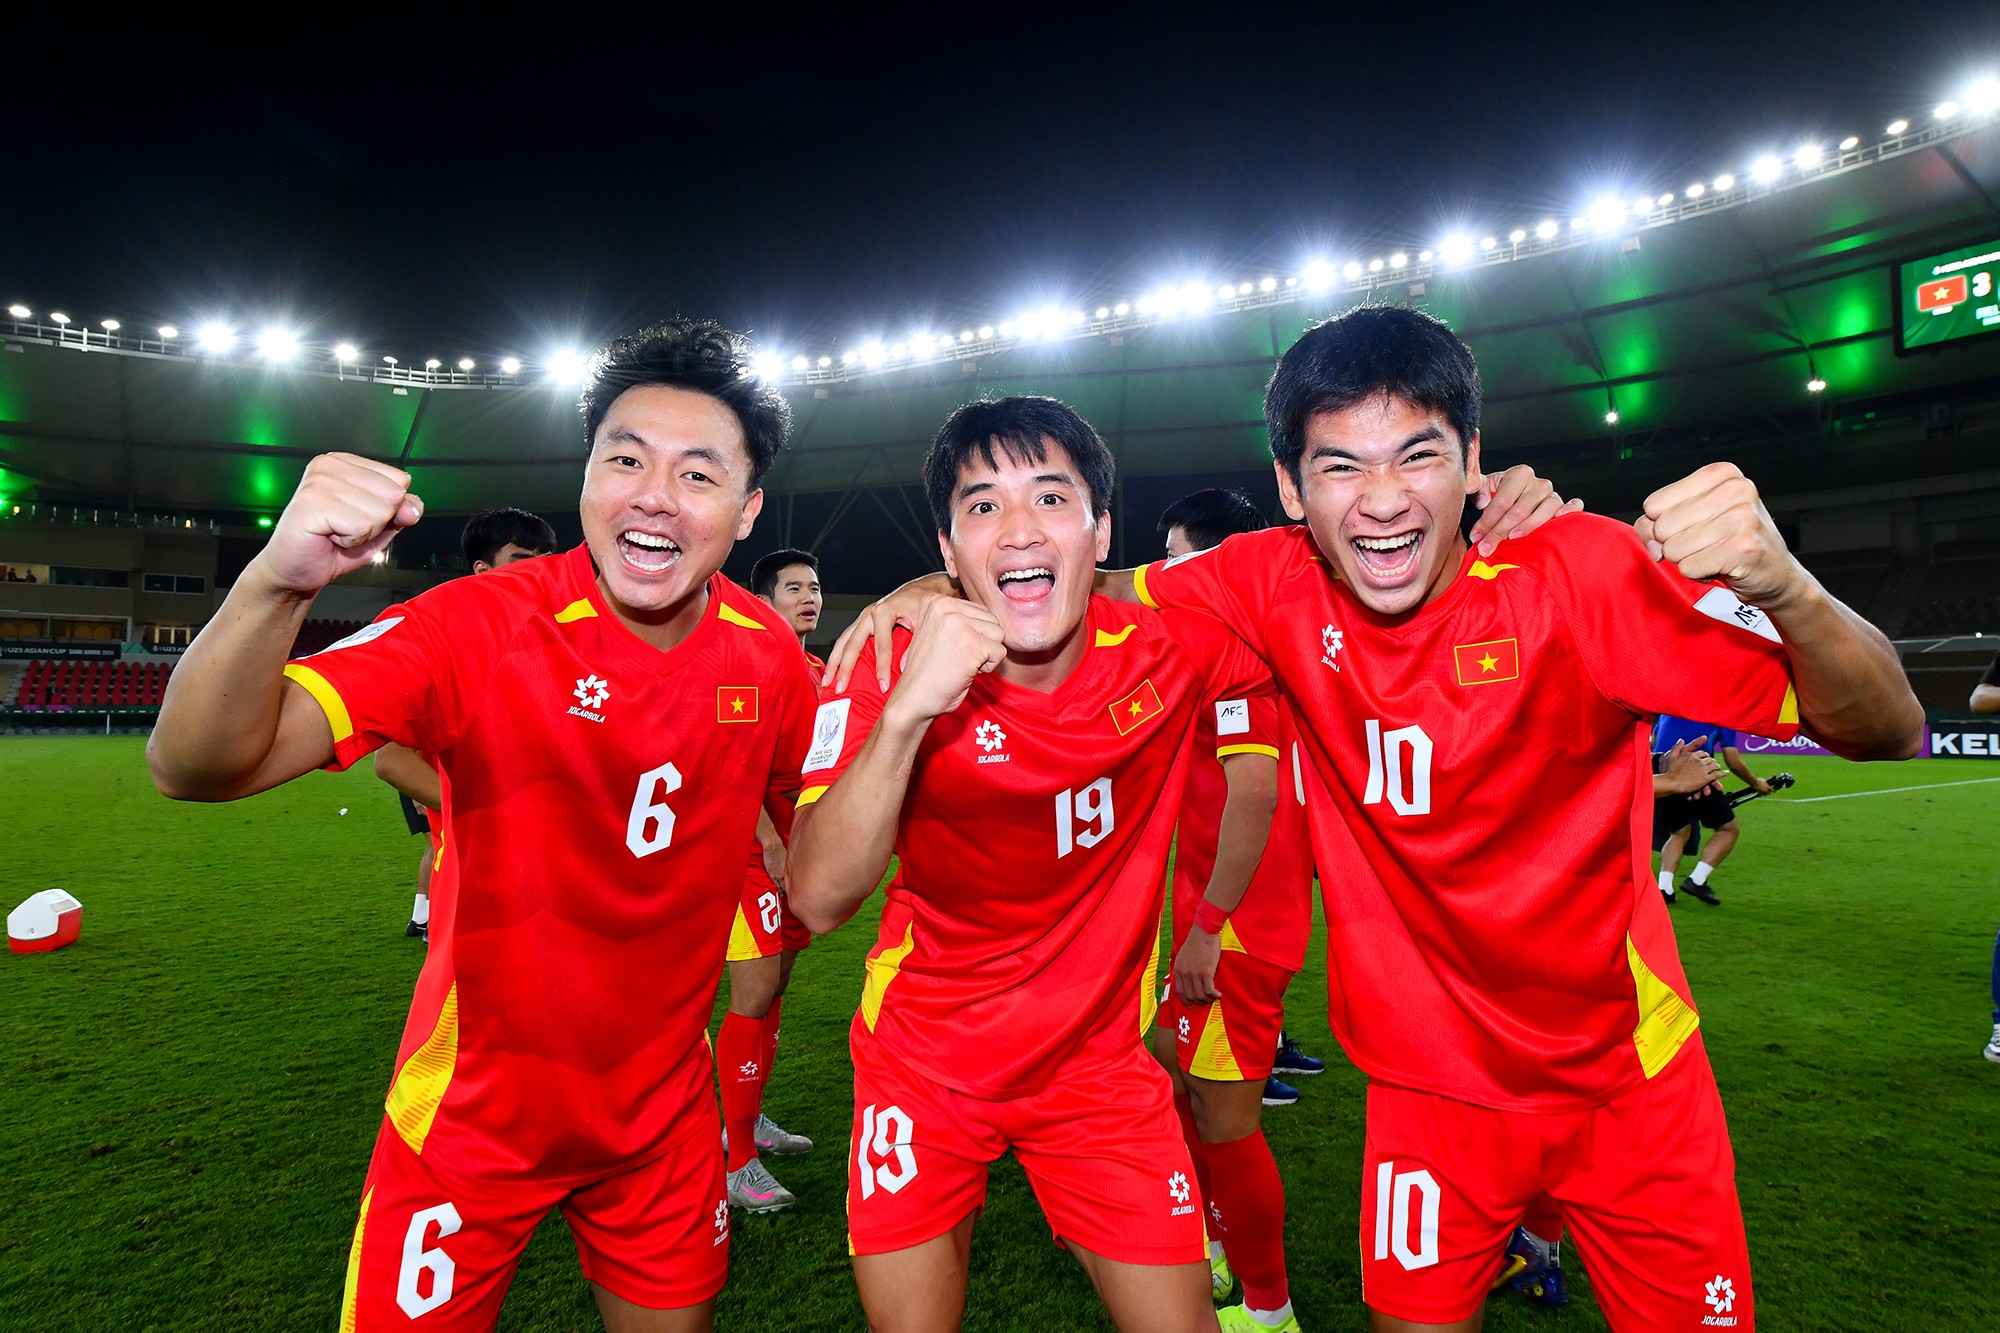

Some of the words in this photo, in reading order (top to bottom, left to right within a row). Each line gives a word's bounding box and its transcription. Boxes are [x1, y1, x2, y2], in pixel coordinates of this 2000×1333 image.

[1972, 271, 1992, 297] 3
[566, 705, 606, 724] JOGARBOLA
[1220, 705, 1243, 718] AFC
[1931, 732, 2000, 755] KEL
[1364, 719, 1433, 816] 10
[625, 761, 682, 859] 6
[1055, 777, 1114, 860] 19
[757, 891, 782, 934] 2
[857, 1103, 918, 1201] 19
[1374, 1161, 1441, 1271] 10
[395, 1201, 463, 1320] 6
